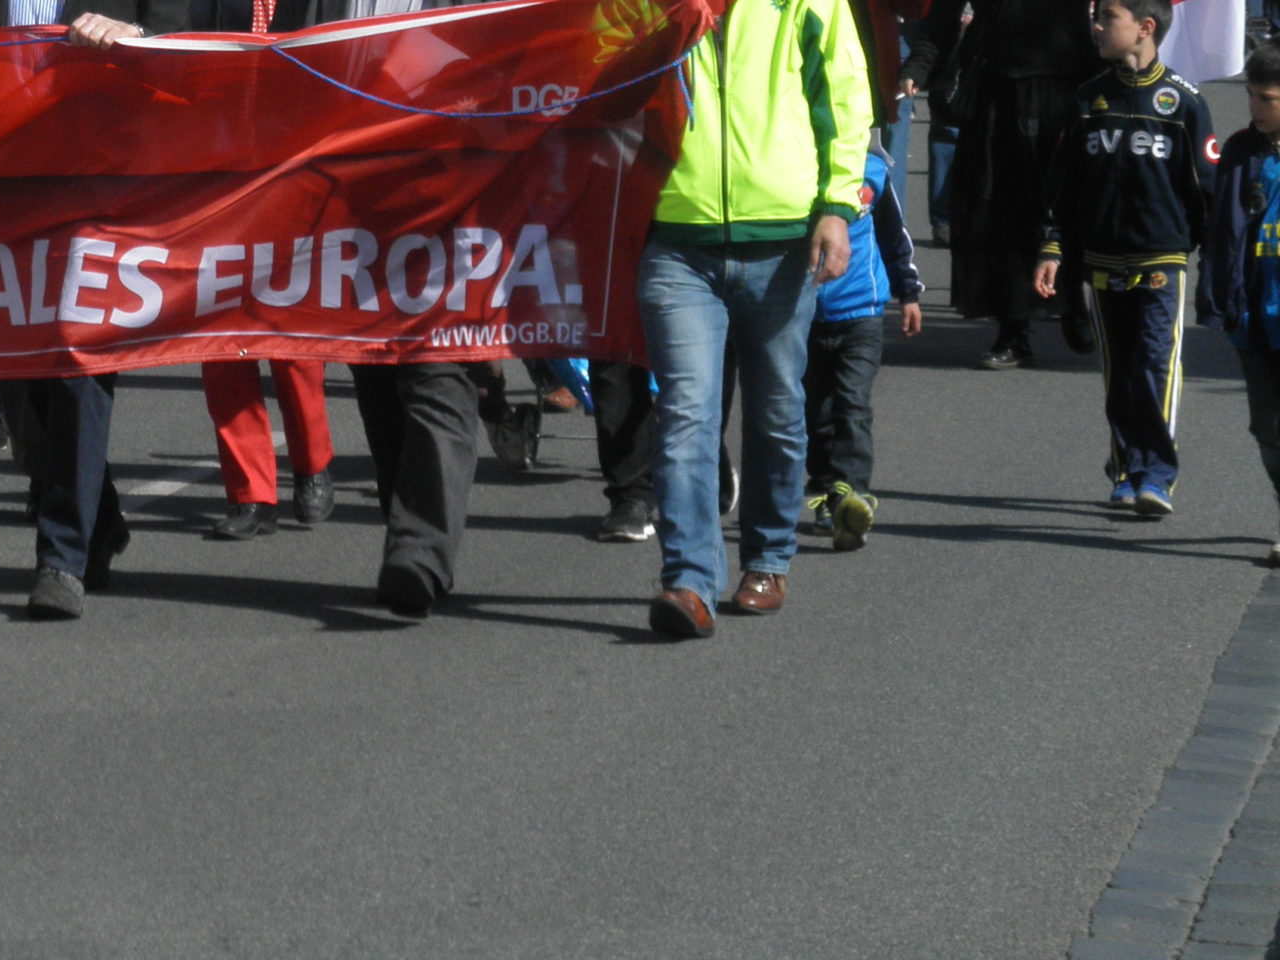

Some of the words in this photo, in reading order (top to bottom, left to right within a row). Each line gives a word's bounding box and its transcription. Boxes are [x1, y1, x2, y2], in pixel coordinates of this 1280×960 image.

[514, 83, 581, 117] DGB
[1086, 128, 1174, 160] avea
[195, 224, 584, 318] EUROPA.
[431, 322, 585, 348] WWW.DGB.DE
